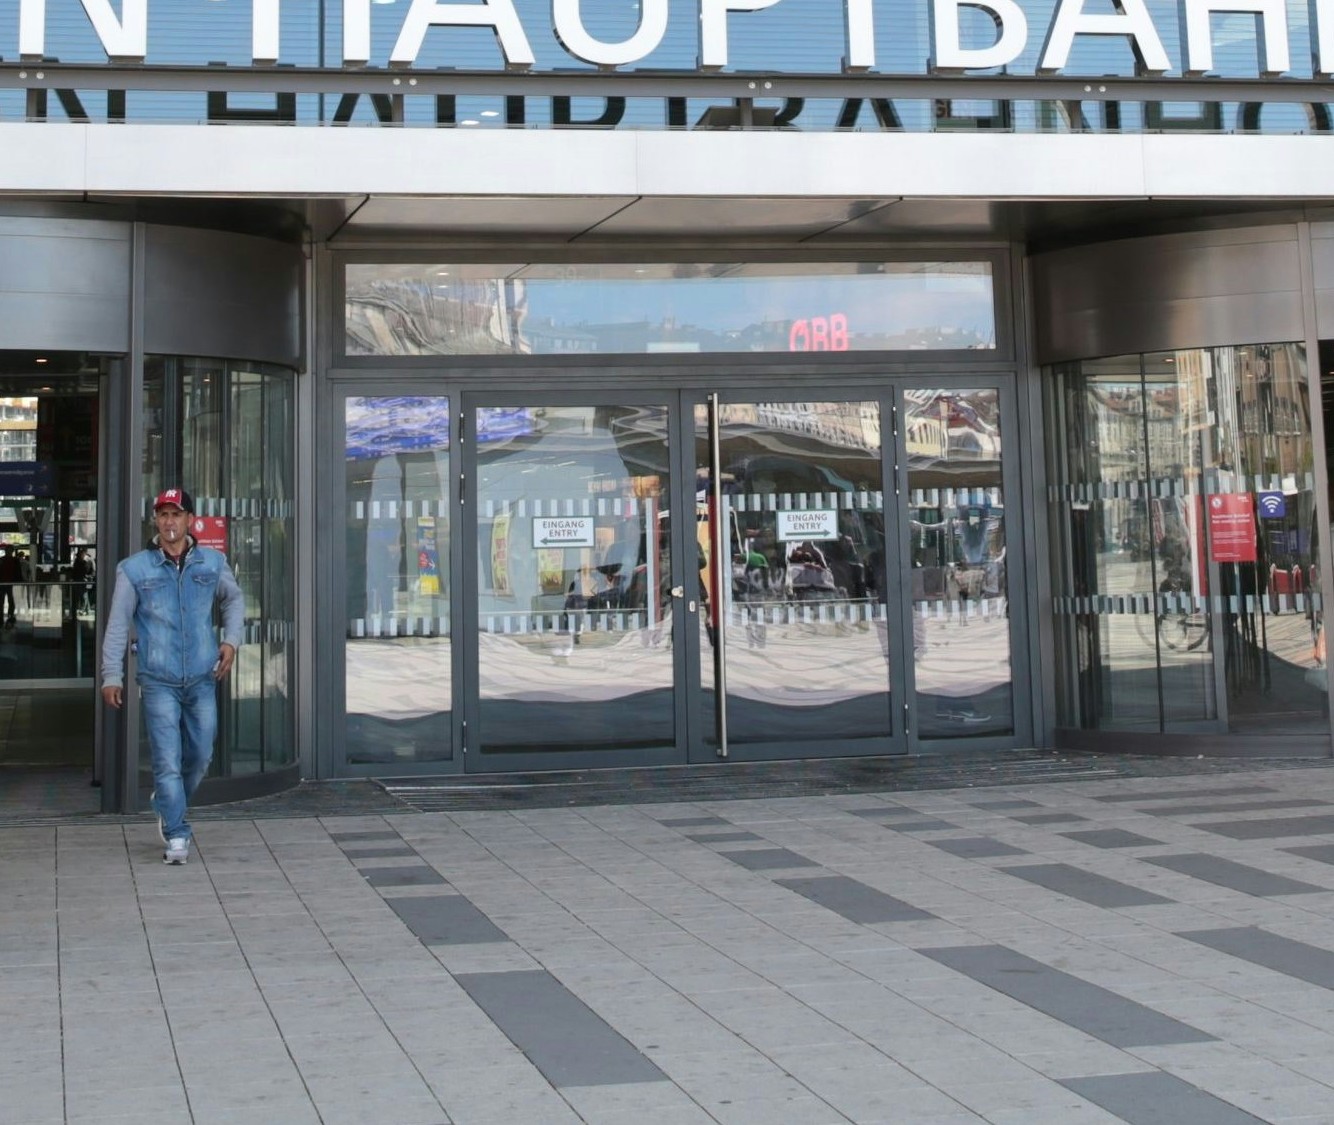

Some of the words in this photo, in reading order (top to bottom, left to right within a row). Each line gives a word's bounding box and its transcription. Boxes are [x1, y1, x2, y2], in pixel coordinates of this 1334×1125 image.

[787, 513, 827, 522] EINGANG
[542, 520, 585, 529] EINGANG
[793, 522, 821, 531] ENTRY
[549, 529, 579, 537] ENTRY
